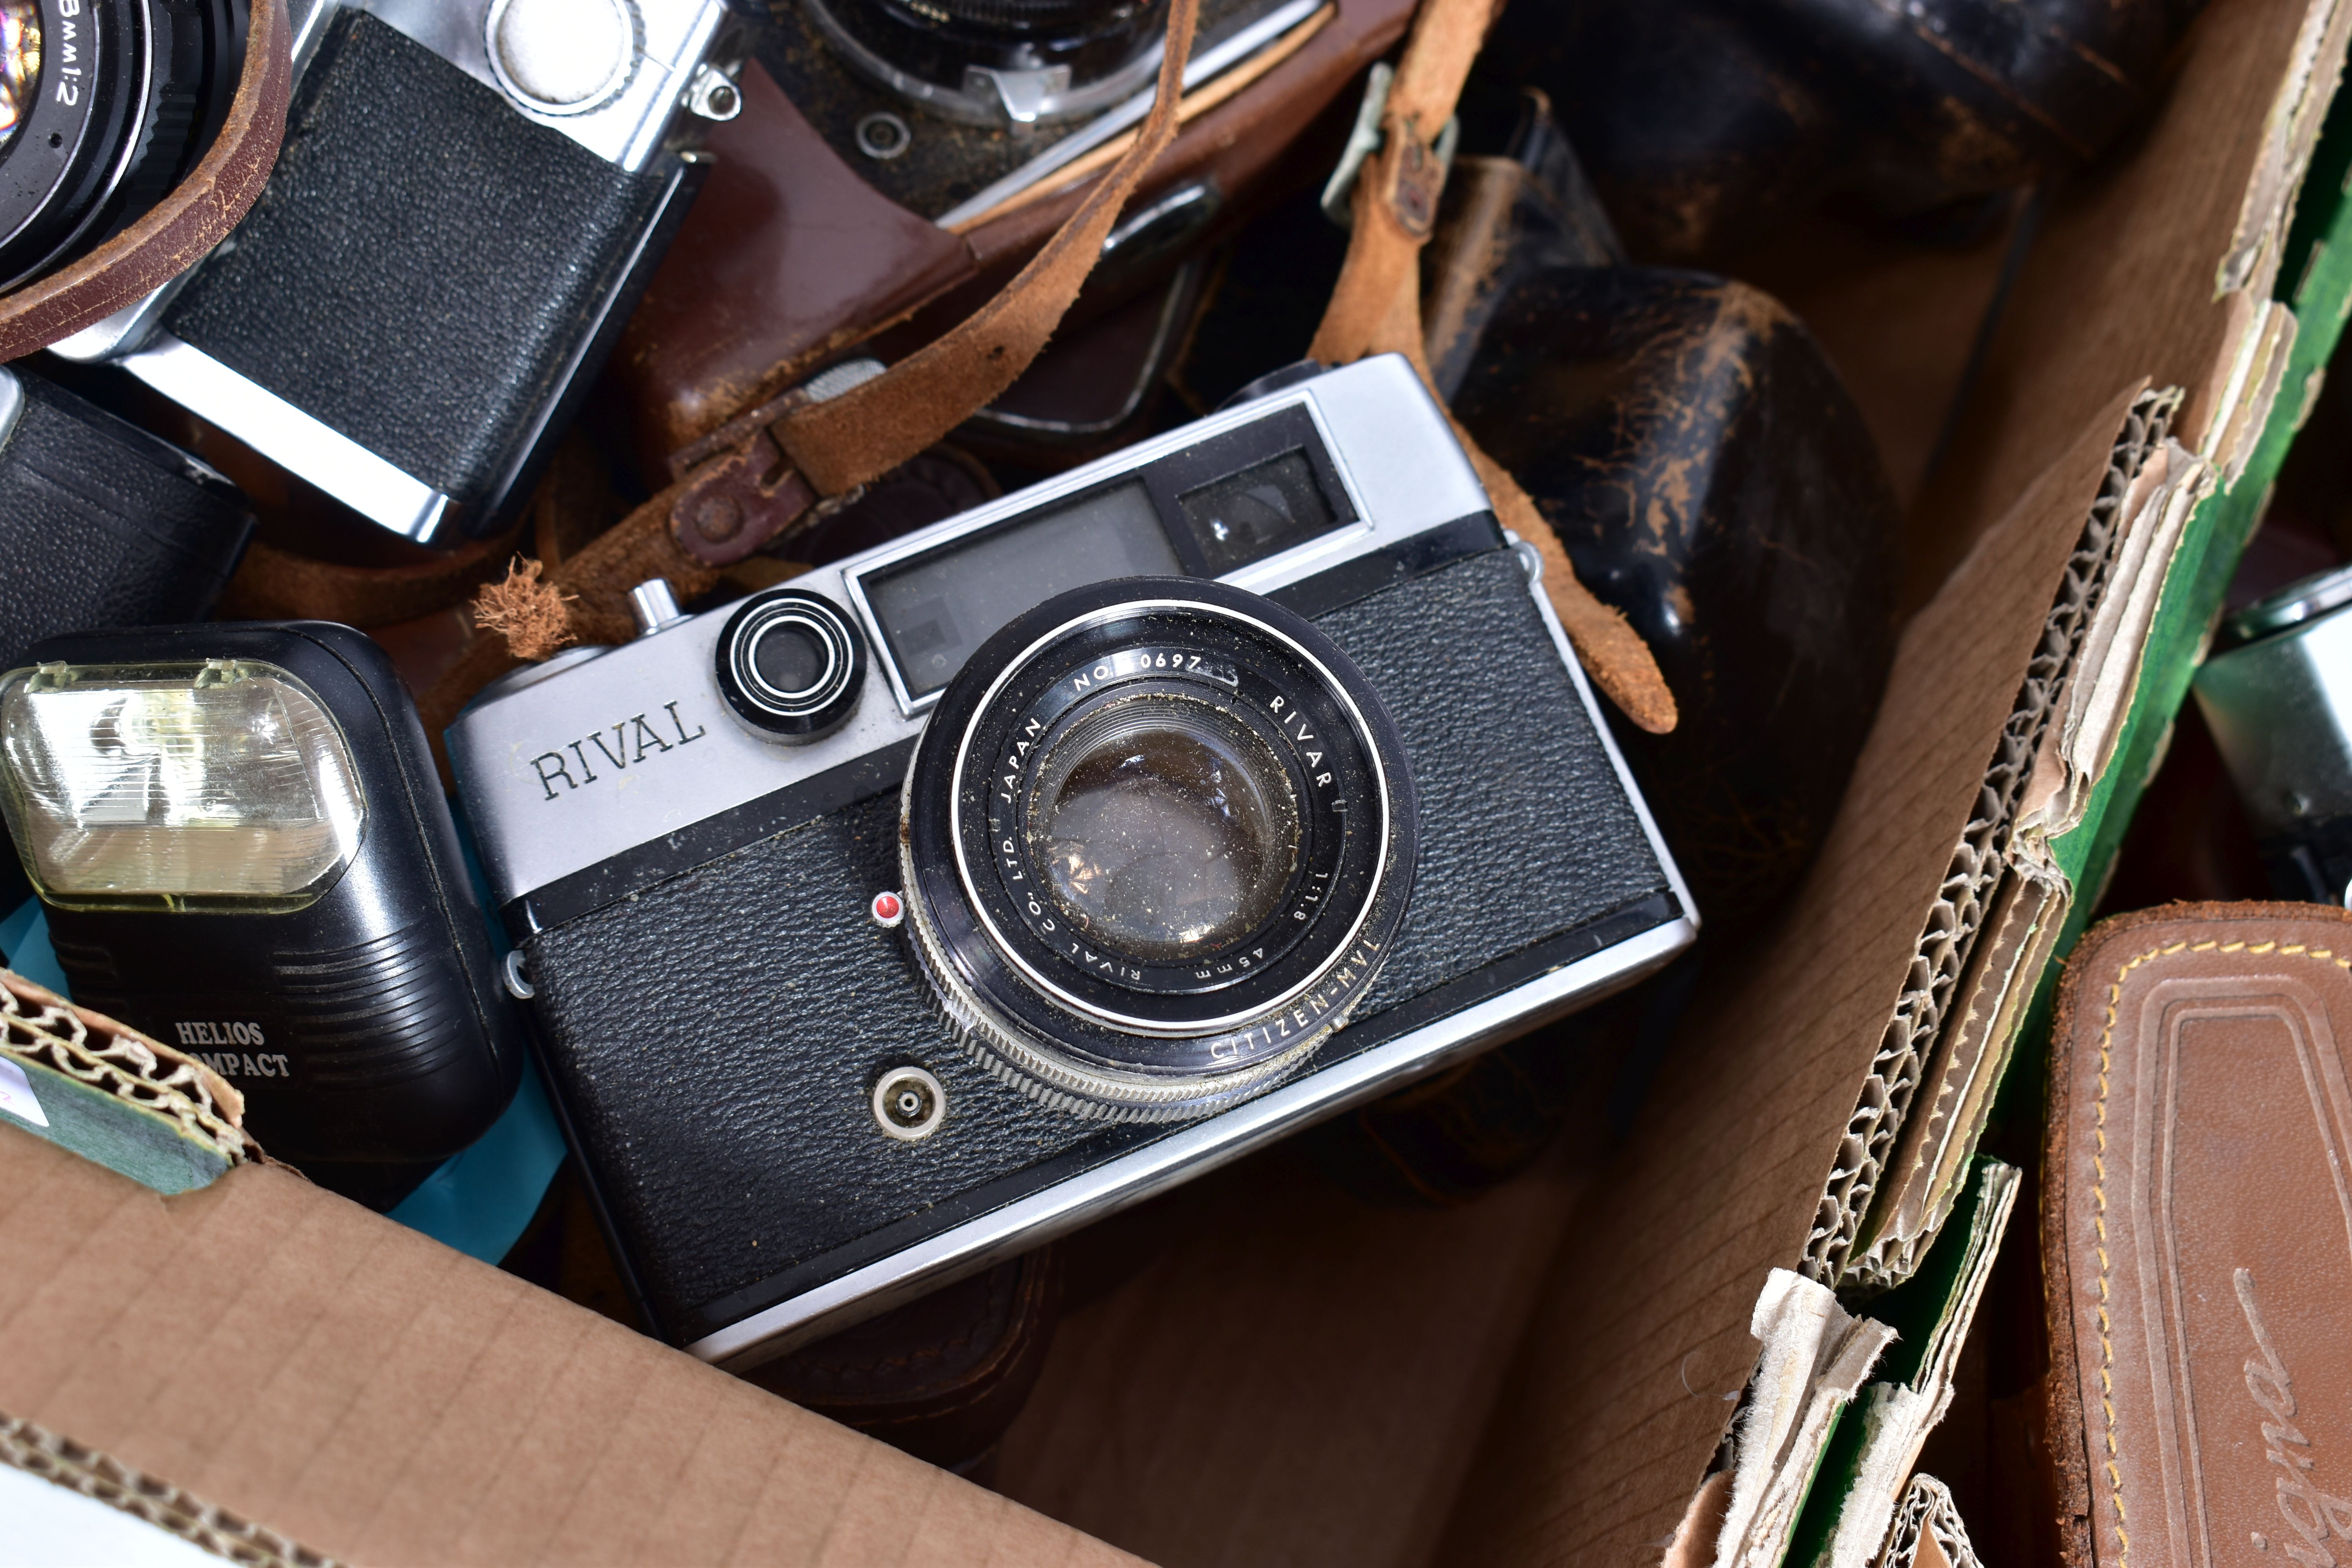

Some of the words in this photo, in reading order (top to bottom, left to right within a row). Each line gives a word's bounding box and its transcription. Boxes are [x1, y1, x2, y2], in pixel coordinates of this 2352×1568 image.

[1074, 665, 1113, 691] NO.
[1140, 653, 1201, 669] 0697
[530, 699, 706, 801] RIVAL
[1001, 718, 1041, 804] JAPAN
[1269, 695, 1332, 787] RIVAR
[1003, 837, 1023, 880] LTD.
[1294, 872, 1328, 920] 1:1.8
[1072, 942, 1140, 980] RIVAL
[1195, 947, 1263, 979] 45mm
[1210, 940, 1381, 1059] CITIZEN-MVL
[175, 1022, 265, 1045] HELIOS
